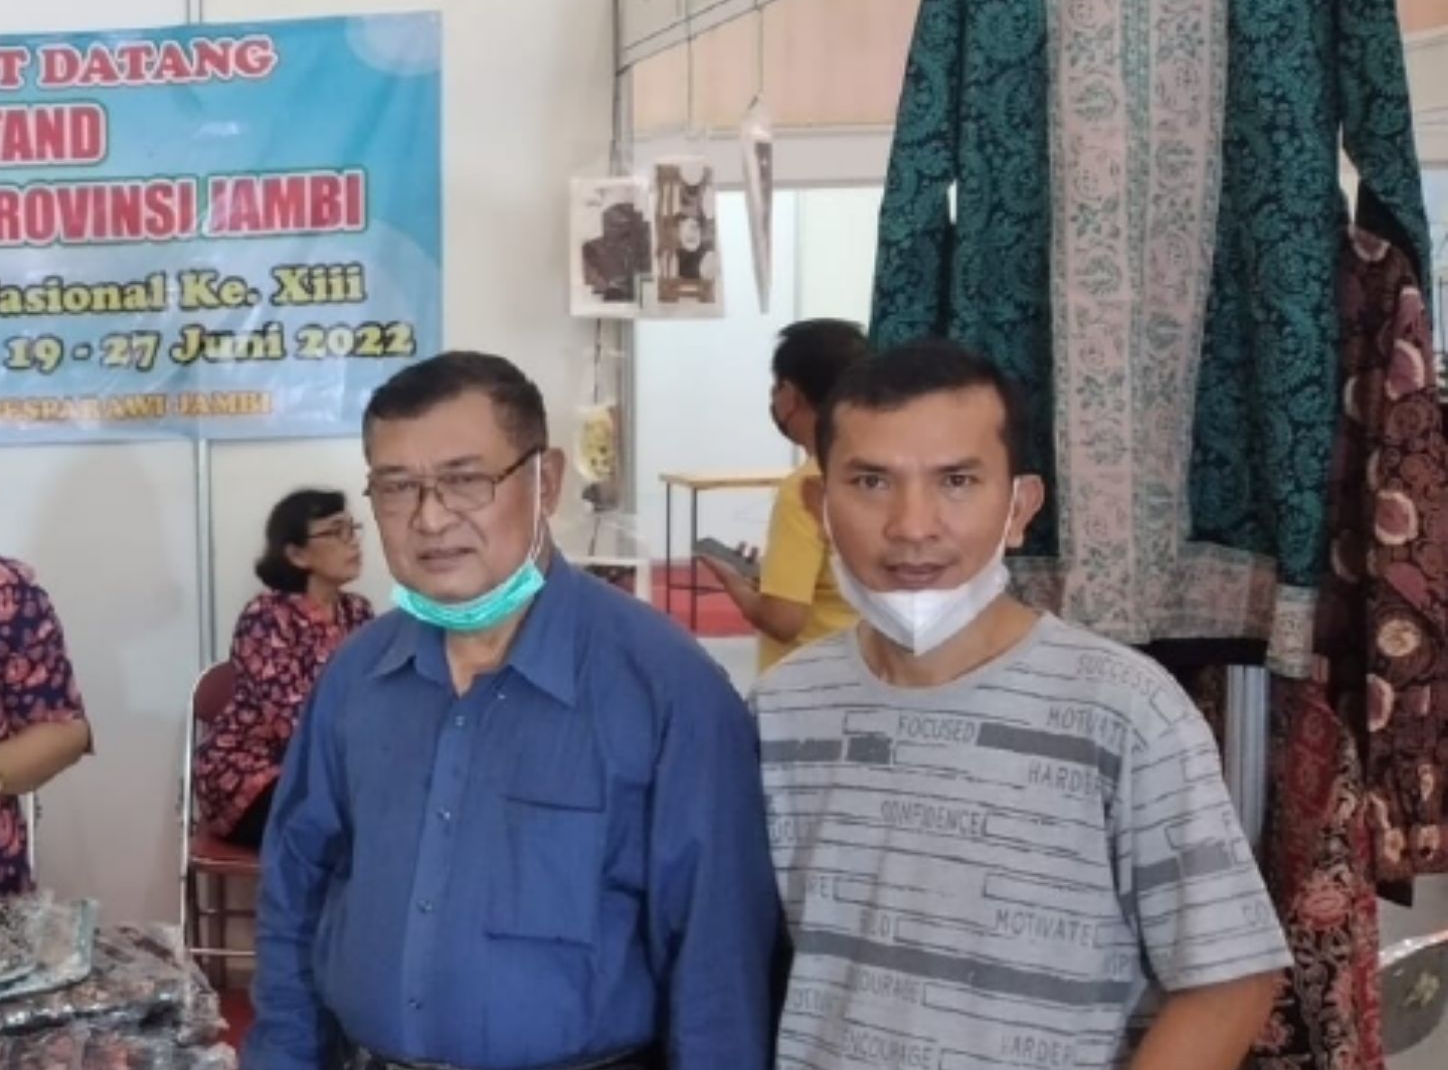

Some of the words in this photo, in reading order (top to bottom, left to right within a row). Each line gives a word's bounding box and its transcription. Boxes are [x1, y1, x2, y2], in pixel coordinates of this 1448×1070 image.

[38, 37, 277, 87] DATANG
[204, 169, 366, 236] JAMBI
[179, 269, 259, 310] Ke.
[272, 263, 366, 307] Xiii
[6, 337, 63, 373] 19
[100, 331, 161, 370] 27
[171, 322, 284, 364] Juni
[295, 322, 416, 360] 2022
[176, 391, 272, 417] JAMBI
[897, 714, 976, 743] FOCUSED
[995, 908, 1094, 948] MOTIVATE
